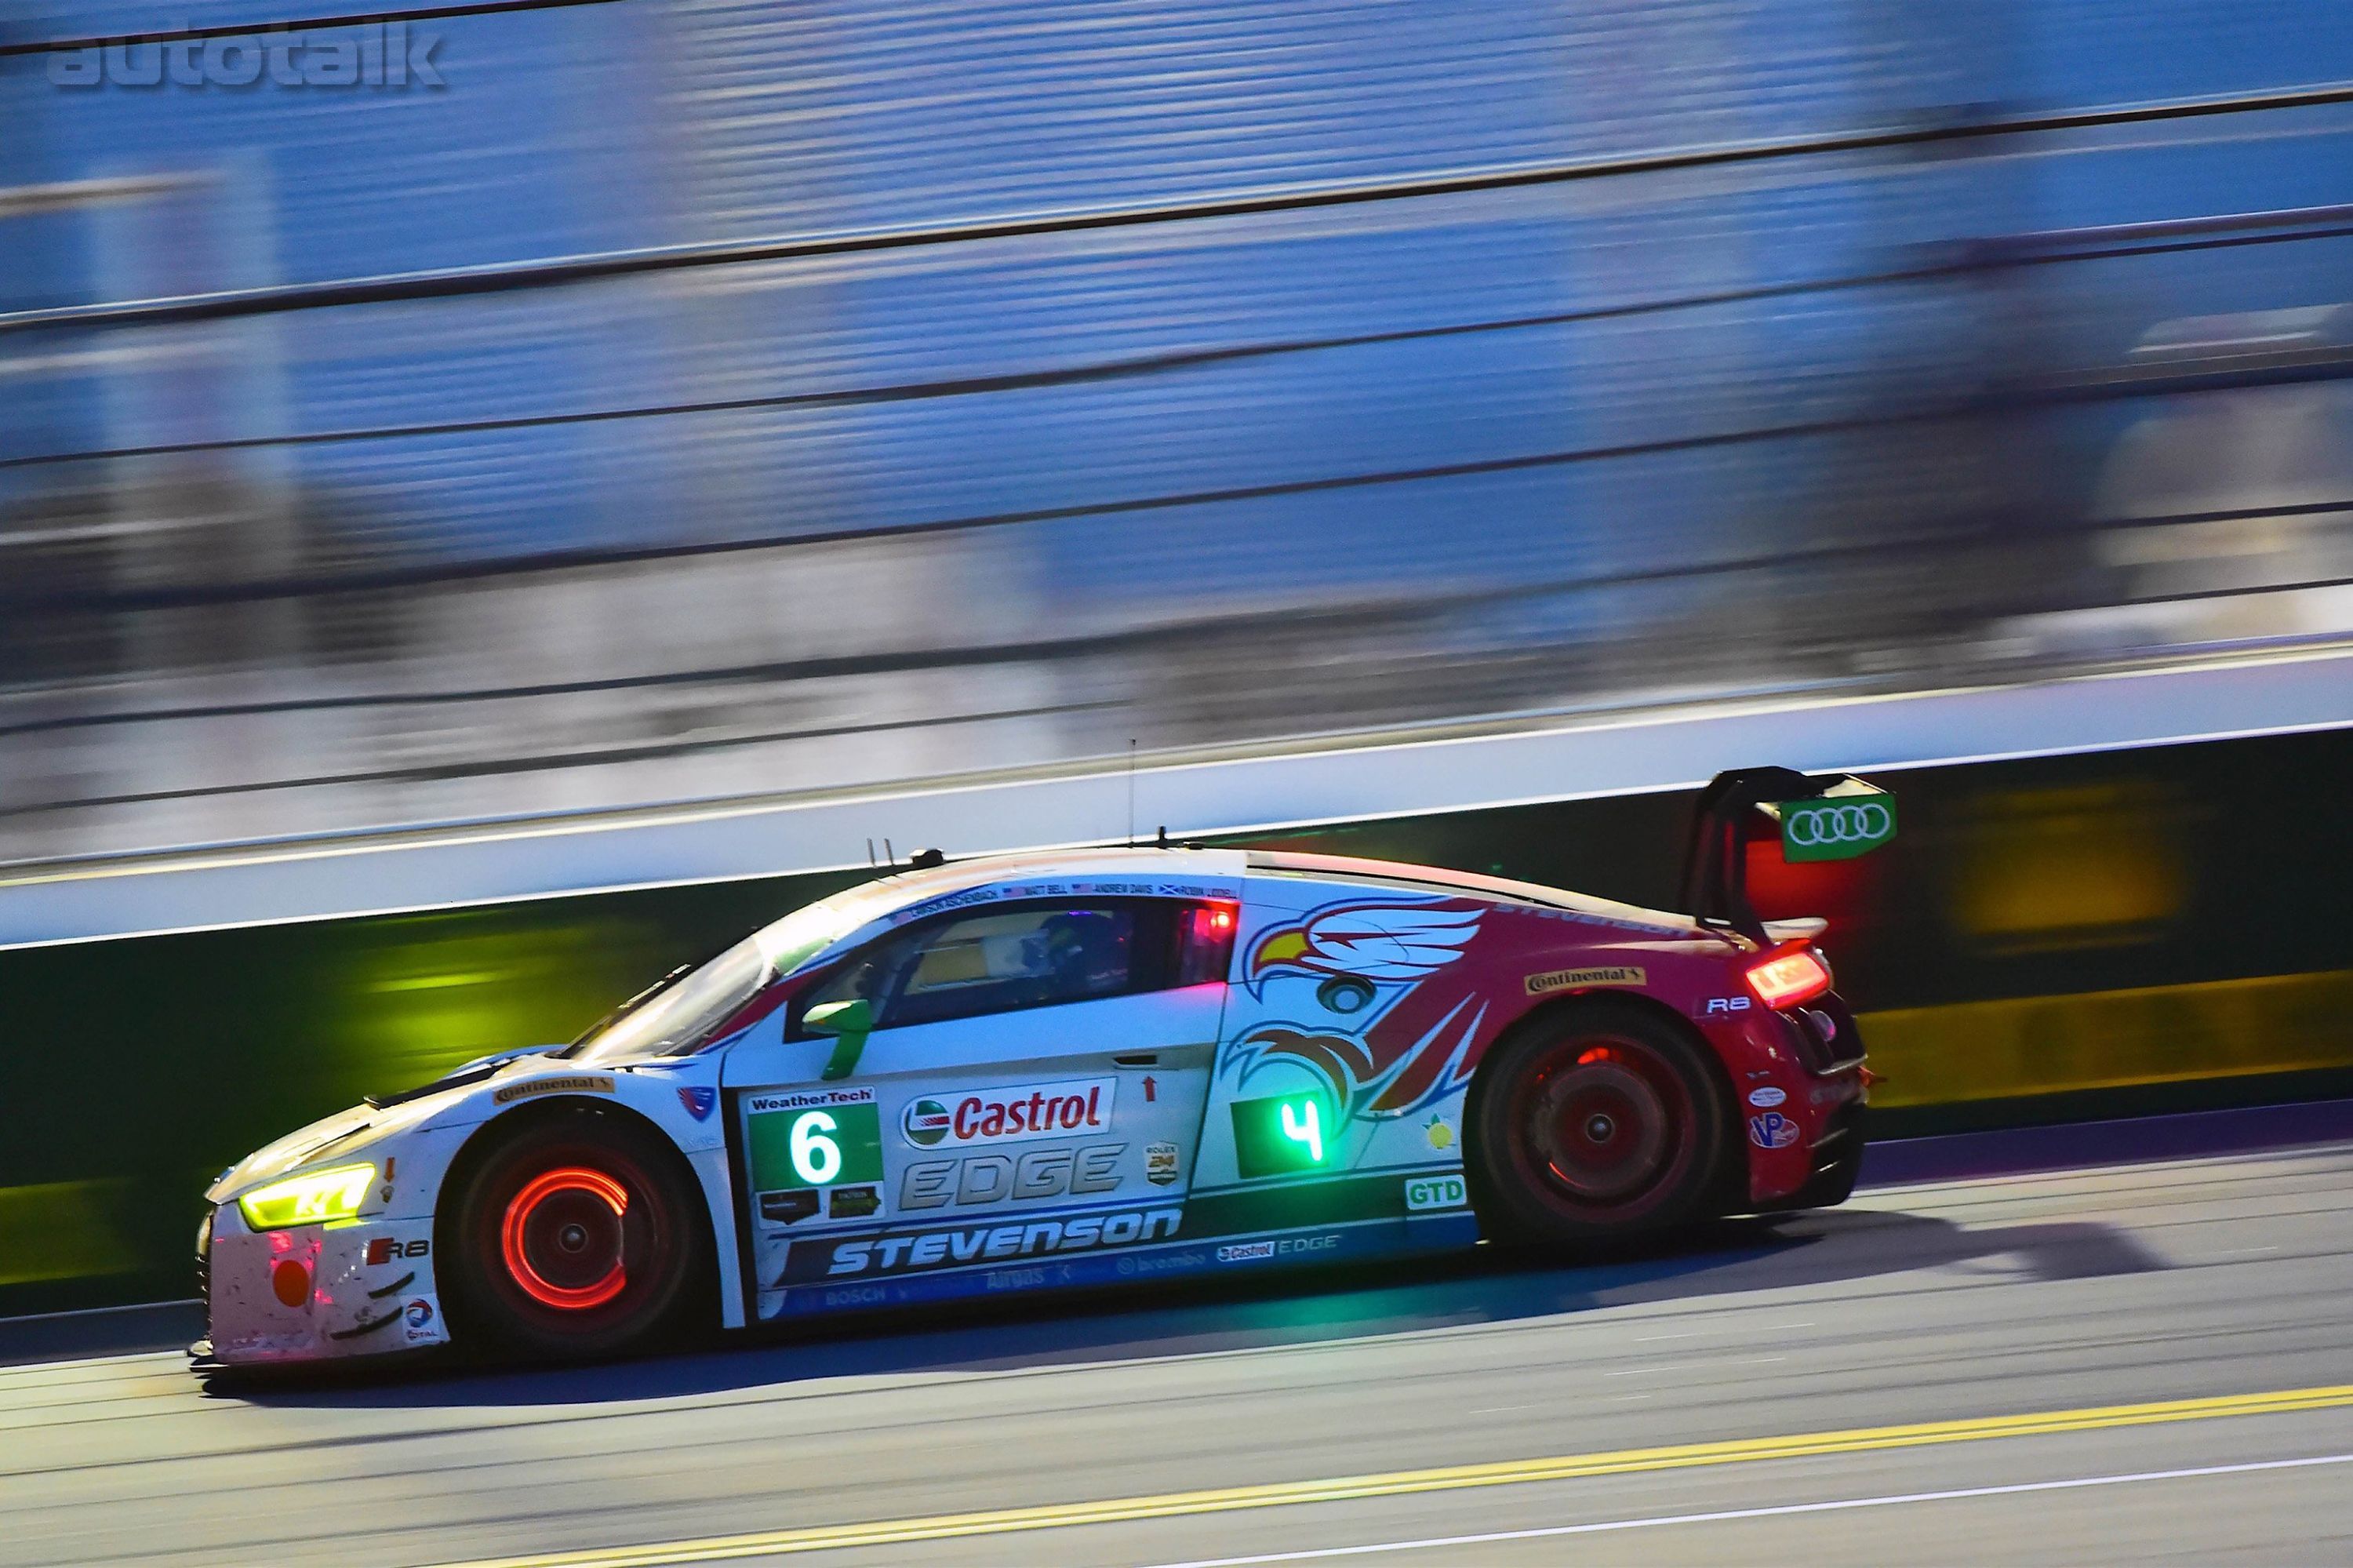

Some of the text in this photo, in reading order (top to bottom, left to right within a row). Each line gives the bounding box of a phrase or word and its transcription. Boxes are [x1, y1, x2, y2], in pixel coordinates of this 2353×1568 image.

[1528, 969, 1625, 991] Continental
[1707, 995, 1751, 1014] R8
[496, 1078, 595, 1102] Continental
[752, 1090, 871, 1111] WeatherTech
[954, 1086, 1100, 1140] Castrol
[1281, 1099, 1323, 1162] 4
[1750, 1112, 1784, 1147] VP
[790, 1111, 842, 1184] 6
[898, 1143, 1129, 1211] EDGE
[1410, 1181, 1463, 1204] GTD
[385, 1239, 431, 1259] R8
[827, 1208, 1183, 1275] STEVENSON
[1231, 1235, 1343, 1259] Castrol EDGE
[826, 1286, 886, 1306] BOSCH
